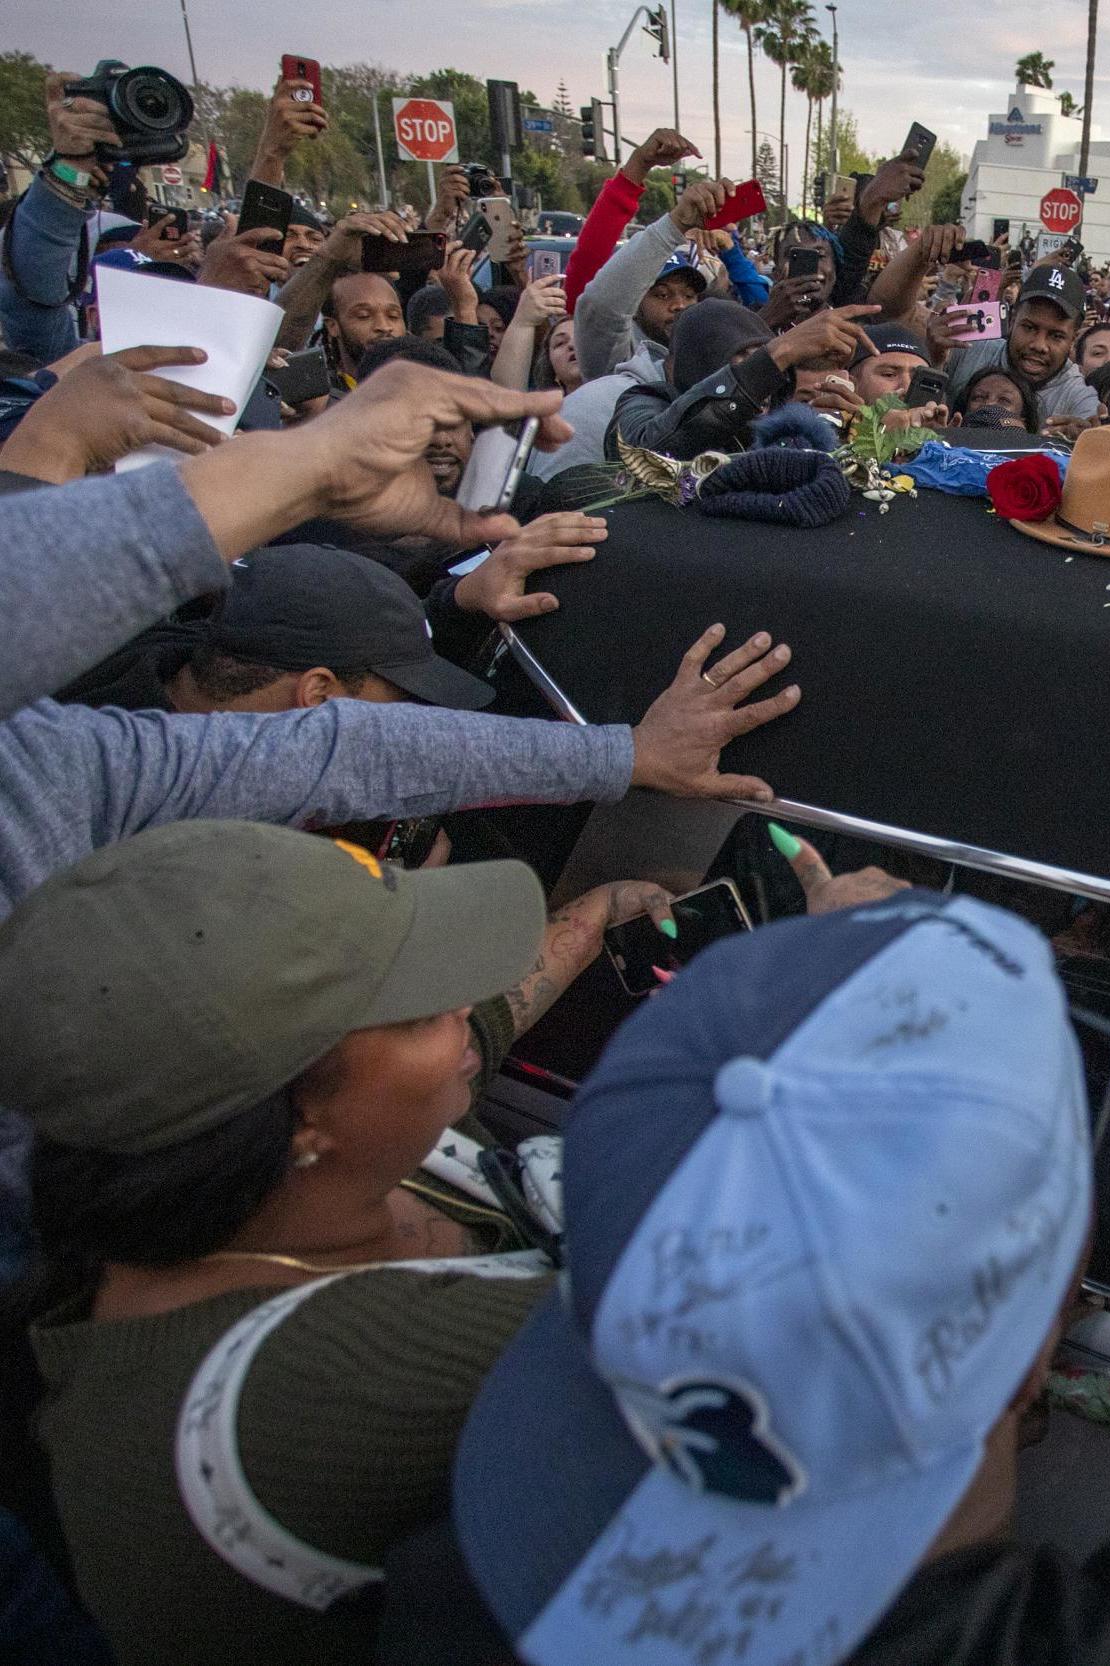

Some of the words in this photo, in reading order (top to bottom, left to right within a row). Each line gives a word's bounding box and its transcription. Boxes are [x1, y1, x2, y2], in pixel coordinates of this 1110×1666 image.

[400, 118, 451, 142] STOP
[1042, 201, 1079, 220] STOP
[1048, 269, 1065, 290] LA
